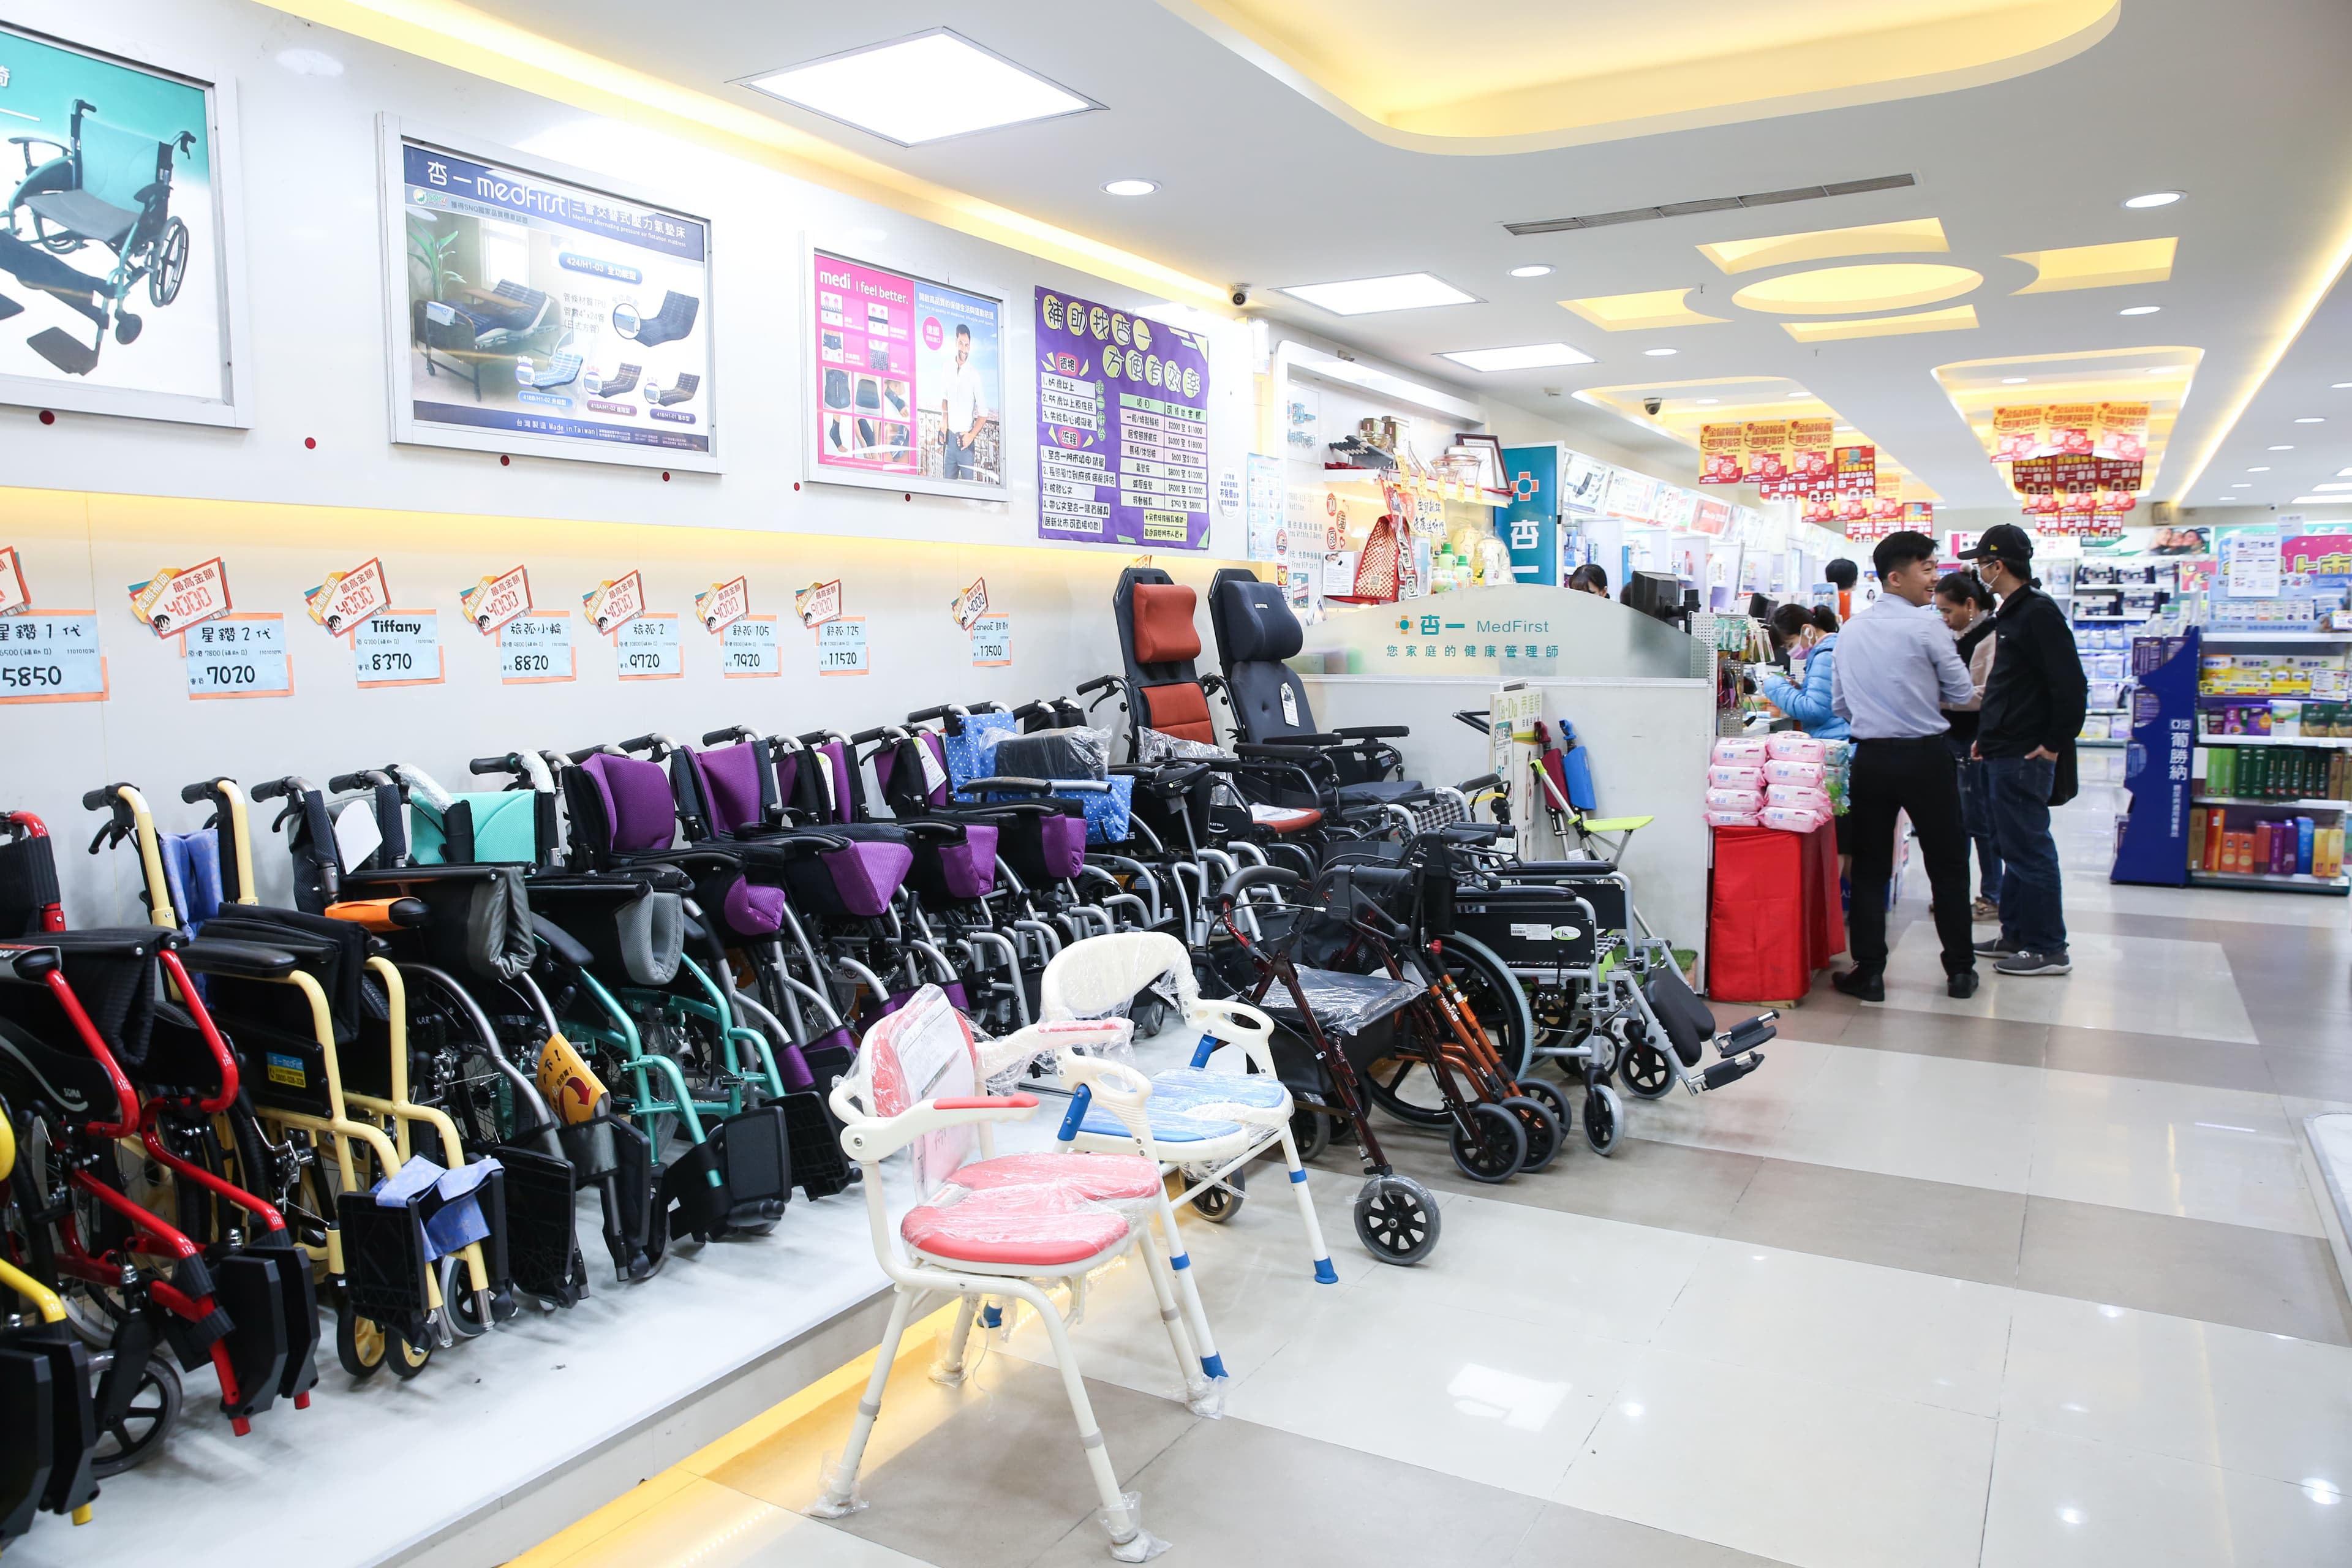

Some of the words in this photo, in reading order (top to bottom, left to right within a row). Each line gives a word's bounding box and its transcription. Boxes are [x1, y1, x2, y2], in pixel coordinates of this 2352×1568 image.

[428, 161, 472, 186] 杏一
[594, 219, 620, 232] alternating
[620, 227, 640, 236] pressure
[668, 238, 686, 247] mattress
[567, 257, 604, 273] 424/H1-03
[608, 267, 637, 281] 全功能型
[820, 270, 851, 290] medi
[861, 281, 877, 296] feel
[880, 286, 909, 304] better.
[1048, 298, 1152, 344] 補助找杏一
[1060, 356, 1076, 372] 資格
[1107, 350, 1200, 393] 方便有效率
[1137, 398, 1150, 409] 項目
[516, 420, 546, 430] 台灣製造
[549, 423, 564, 432] Made
[566, 424, 573, 432] in
[574, 426, 595, 435] Taiwan
[1062, 430, 1077, 446] 流程
[1510, 519, 1539, 574] 杏一
[173, 567, 215, 593] 最高金額
[340, 567, 375, 594] 最高金額
[491, 574, 521, 597] 最高金額
[609, 578, 634, 599] 最高金額
[164, 587, 213, 617] 4000
[335, 585, 375, 616] 4000
[485, 590, 519, 616] 4000
[966, 584, 982, 603] 最高金額
[605, 594, 633, 618] 4000
[714, 597, 739, 619] 4000
[810, 597, 833, 615] 9000
[964, 592, 985, 618] 14000
[202, 627, 271, 642] 星鑽2代
[371, 620, 421, 635] Tiffany
[511, 622, 562, 635] 旅弧小輪
[633, 625, 655, 635] 旅弧
[733, 625, 752, 636] 舒弧
[755, 625, 769, 636] 105
[846, 625, 859, 636] 125
[1420, 615, 1466, 635] 杏一
[1476, 620, 1549, 633] MedFirst
[630, 654, 660, 668] 9720
[734, 654, 760, 668] 7920
[829, 652, 857, 665] 11520
[980, 645, 1002, 657] 13500
[1387, 644, 1559, 658] 您家庭的健康管理師
[372, 653, 412, 671] 8370
[514, 655, 549, 671] 8820
[2, 666, 62, 687] 5850
[207, 665, 255, 685] 7020
[2169, 732, 2190, 781] 葡勝納
[417, 1016, 432, 1025] KAR
